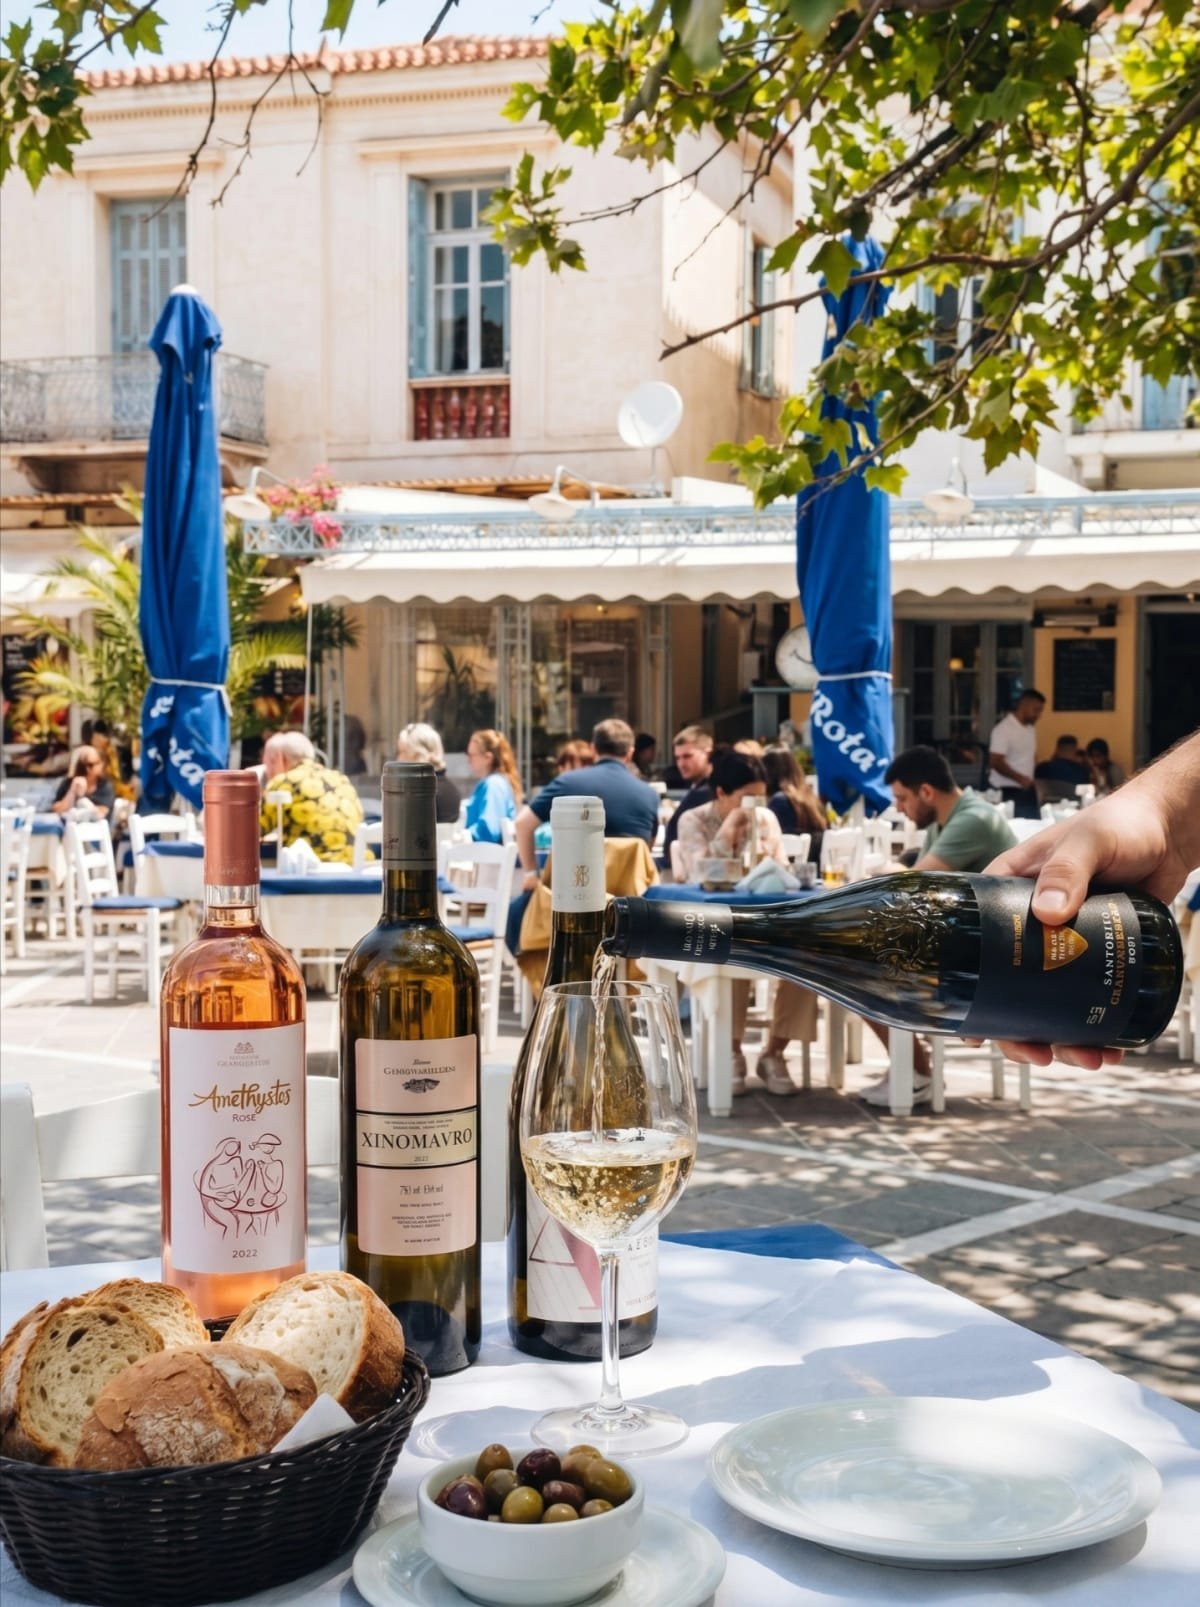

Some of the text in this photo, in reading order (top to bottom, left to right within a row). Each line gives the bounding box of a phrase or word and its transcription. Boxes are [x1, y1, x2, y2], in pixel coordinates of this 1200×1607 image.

[188, 1079, 291, 1114] Amethystos
[361, 1128, 472, 1149] XINOMAVRO
[232, 1249, 258, 1258] 2022
